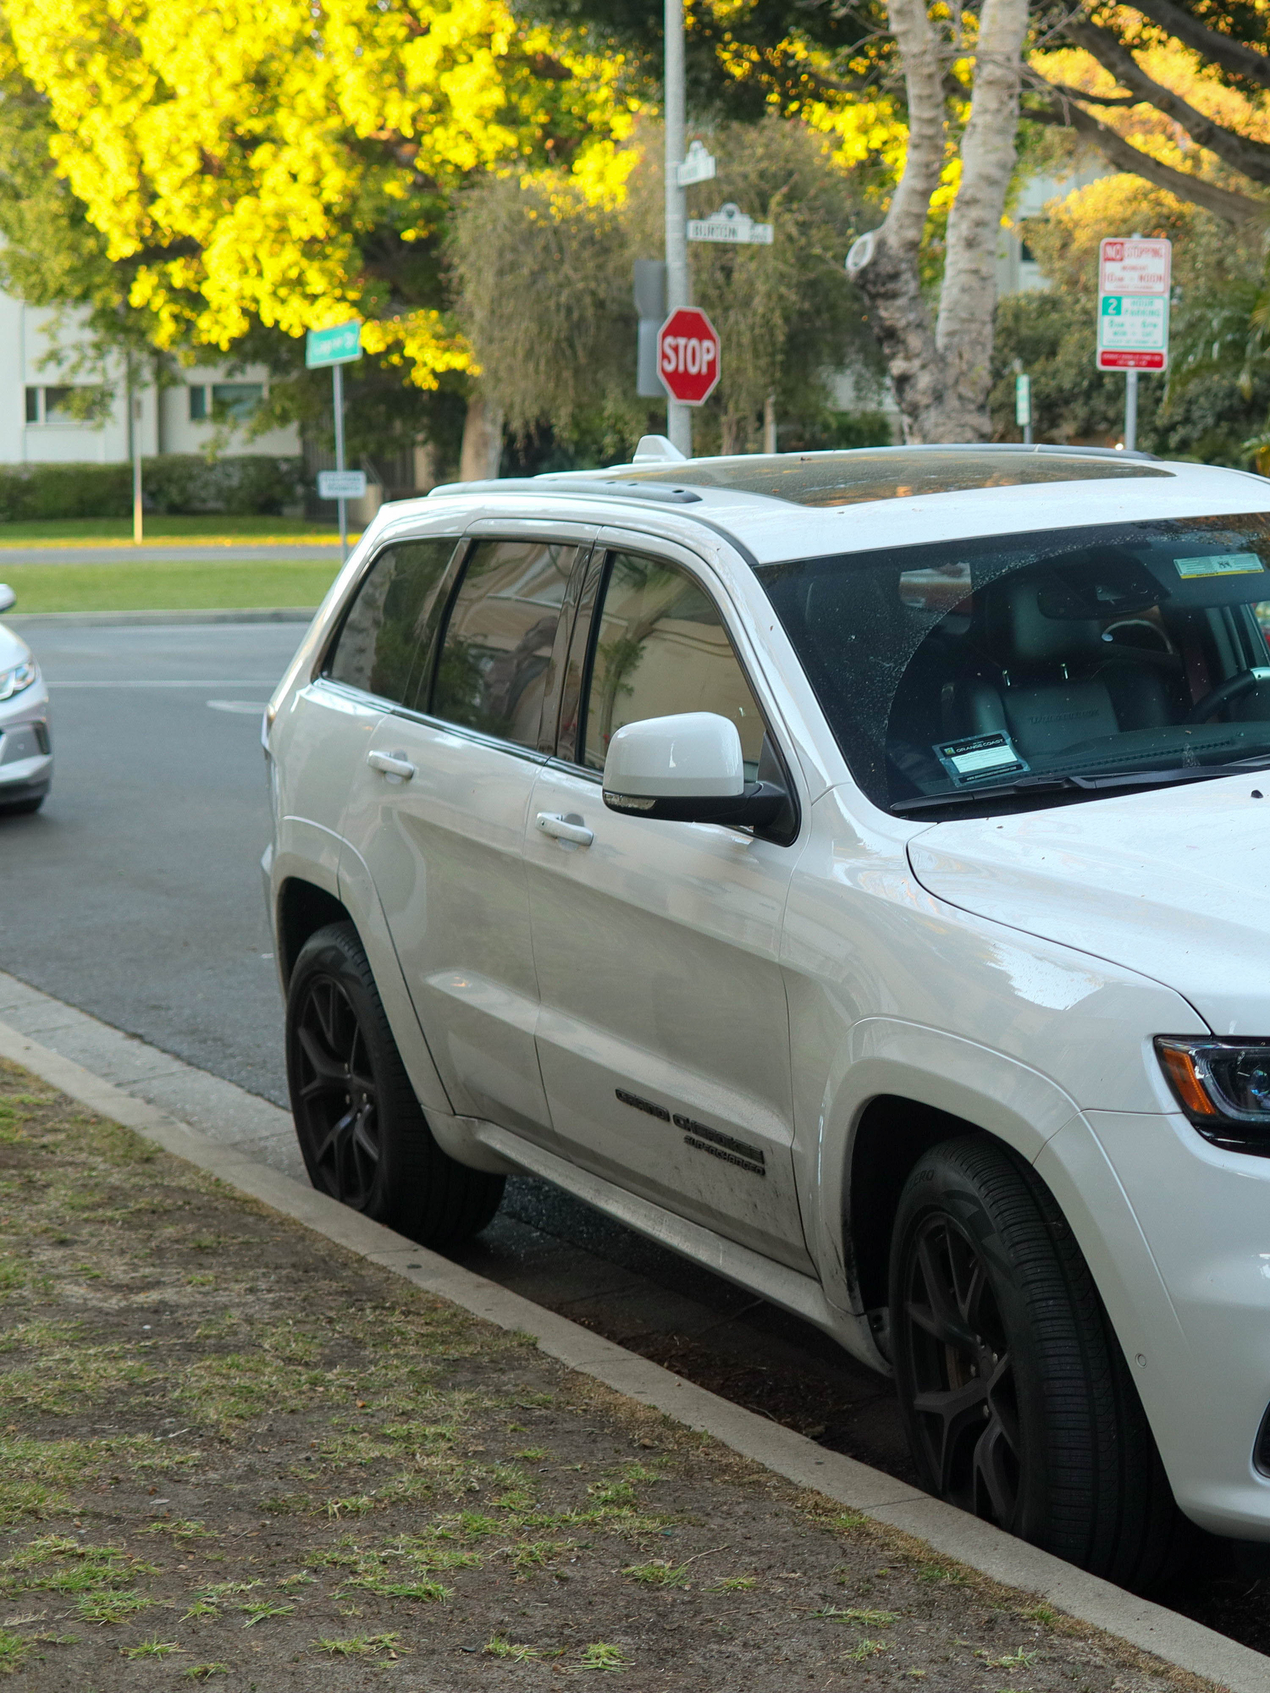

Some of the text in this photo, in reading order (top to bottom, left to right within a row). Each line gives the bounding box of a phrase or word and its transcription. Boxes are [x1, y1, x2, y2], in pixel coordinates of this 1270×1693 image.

[691, 223, 739, 240] BURTON
[1105, 244, 1164, 259] NO STOPPING
[1108, 298, 1118, 315] 2
[662, 335, 716, 376] STOP
[956, 743, 983, 753] ORANGE
[983, 738, 1004, 747] COAST
[615, 1088, 671, 1122] GRAND
[684, 1135, 766, 1176] SUPERCHARGED
